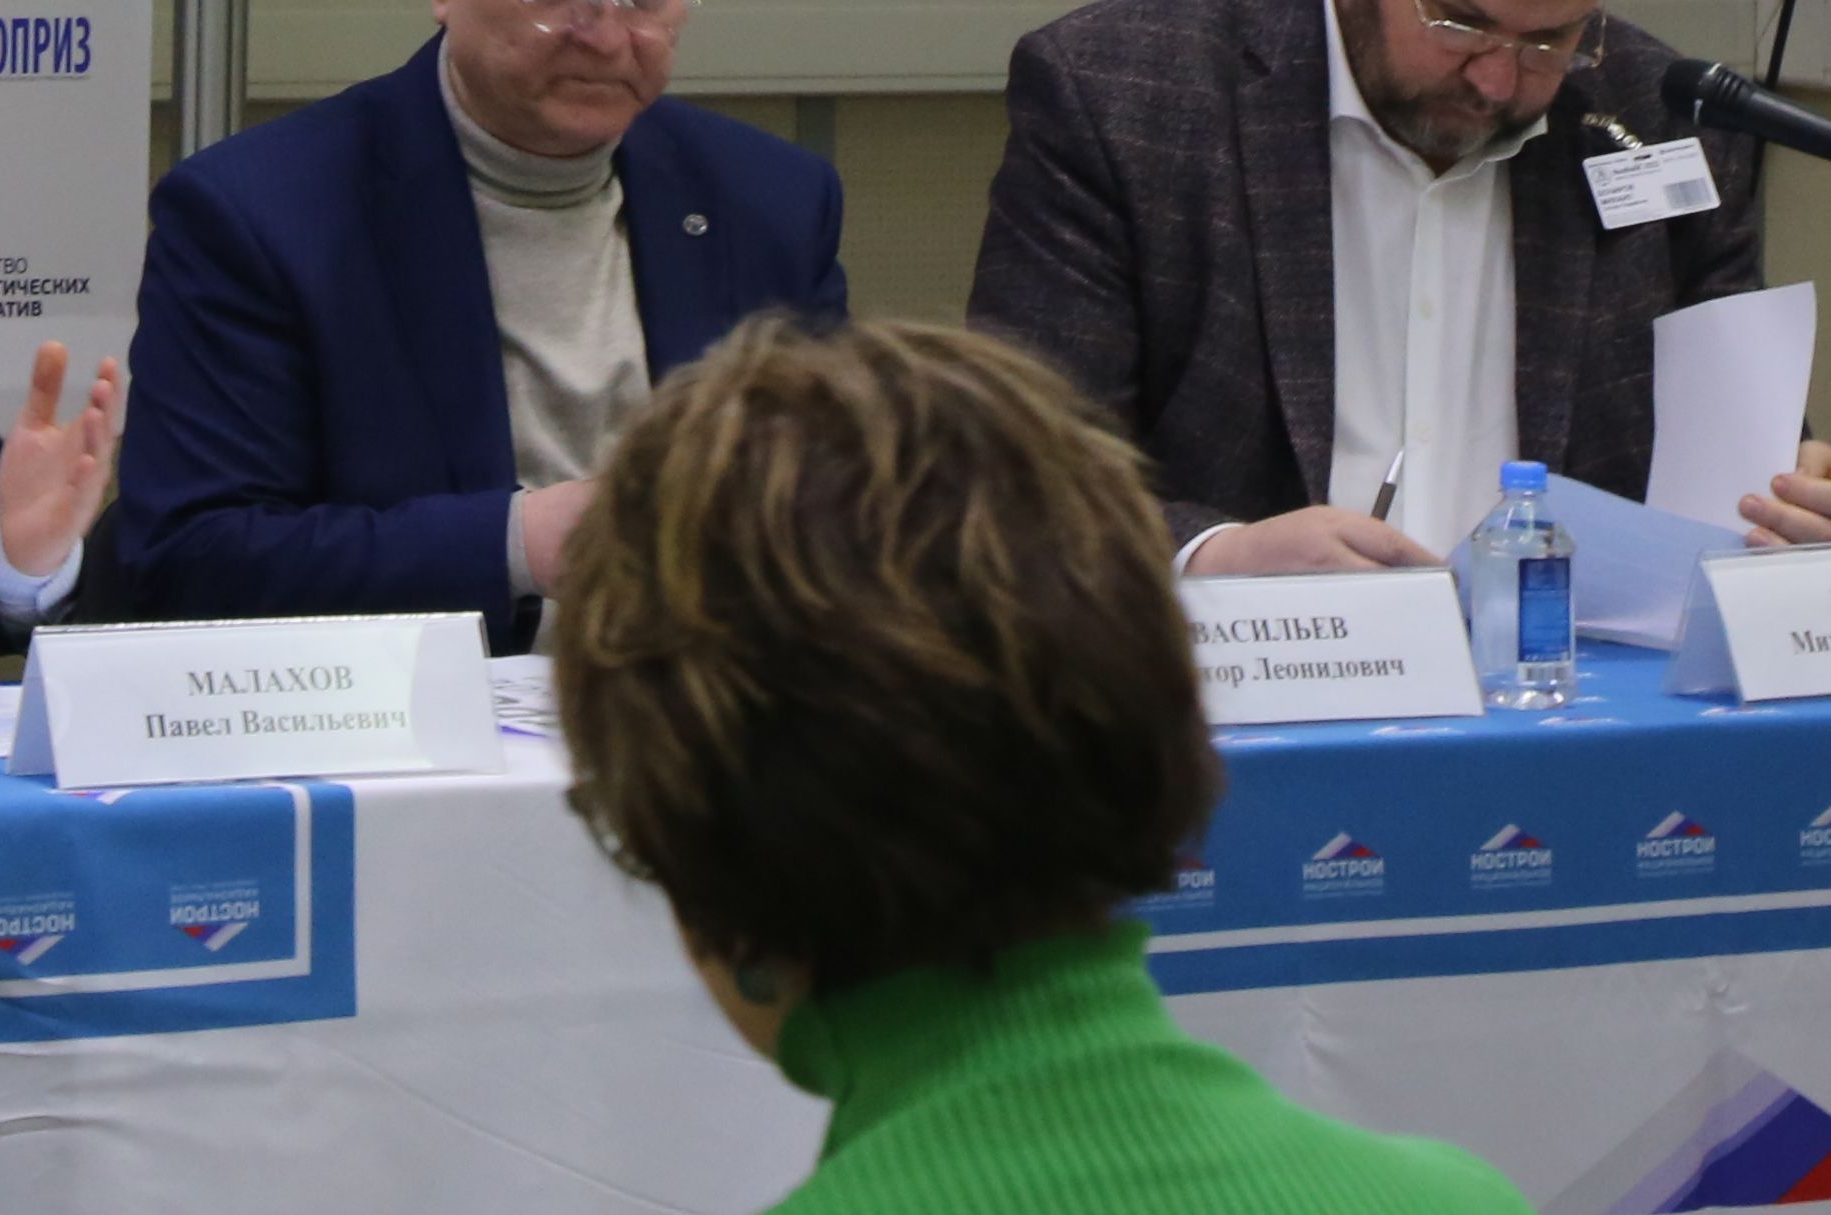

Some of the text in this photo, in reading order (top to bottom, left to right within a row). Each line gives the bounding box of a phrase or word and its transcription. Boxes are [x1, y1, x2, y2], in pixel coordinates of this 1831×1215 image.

[187, 665, 354, 698] МАЛАХОВ
[1252, 657, 1406, 681] Леонидович
[145, 707, 408, 739] Павел Васильевич
